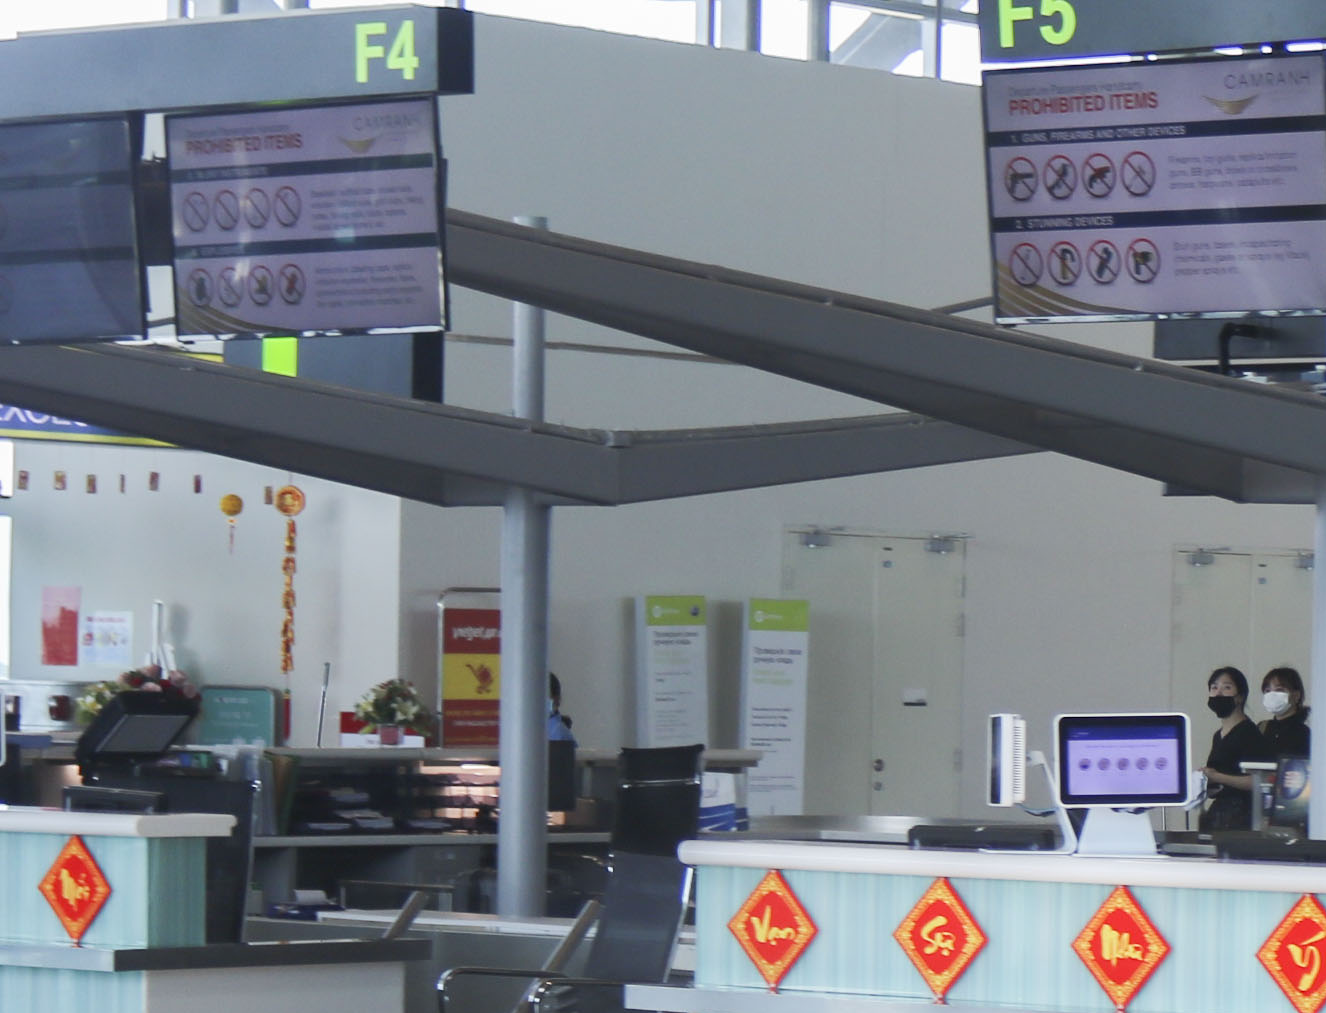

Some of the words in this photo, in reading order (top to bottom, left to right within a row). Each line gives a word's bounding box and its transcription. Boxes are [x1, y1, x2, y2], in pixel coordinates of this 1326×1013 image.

[999, 0, 1077, 48] F5
[354, 19, 419, 83] F4
[1009, 94, 1105, 116] PROHIBITED
[1109, 91, 1158, 111] ITEMS
[185, 134, 261, 154] PROHIBITED
[263, 131, 303, 150] ITEMS
